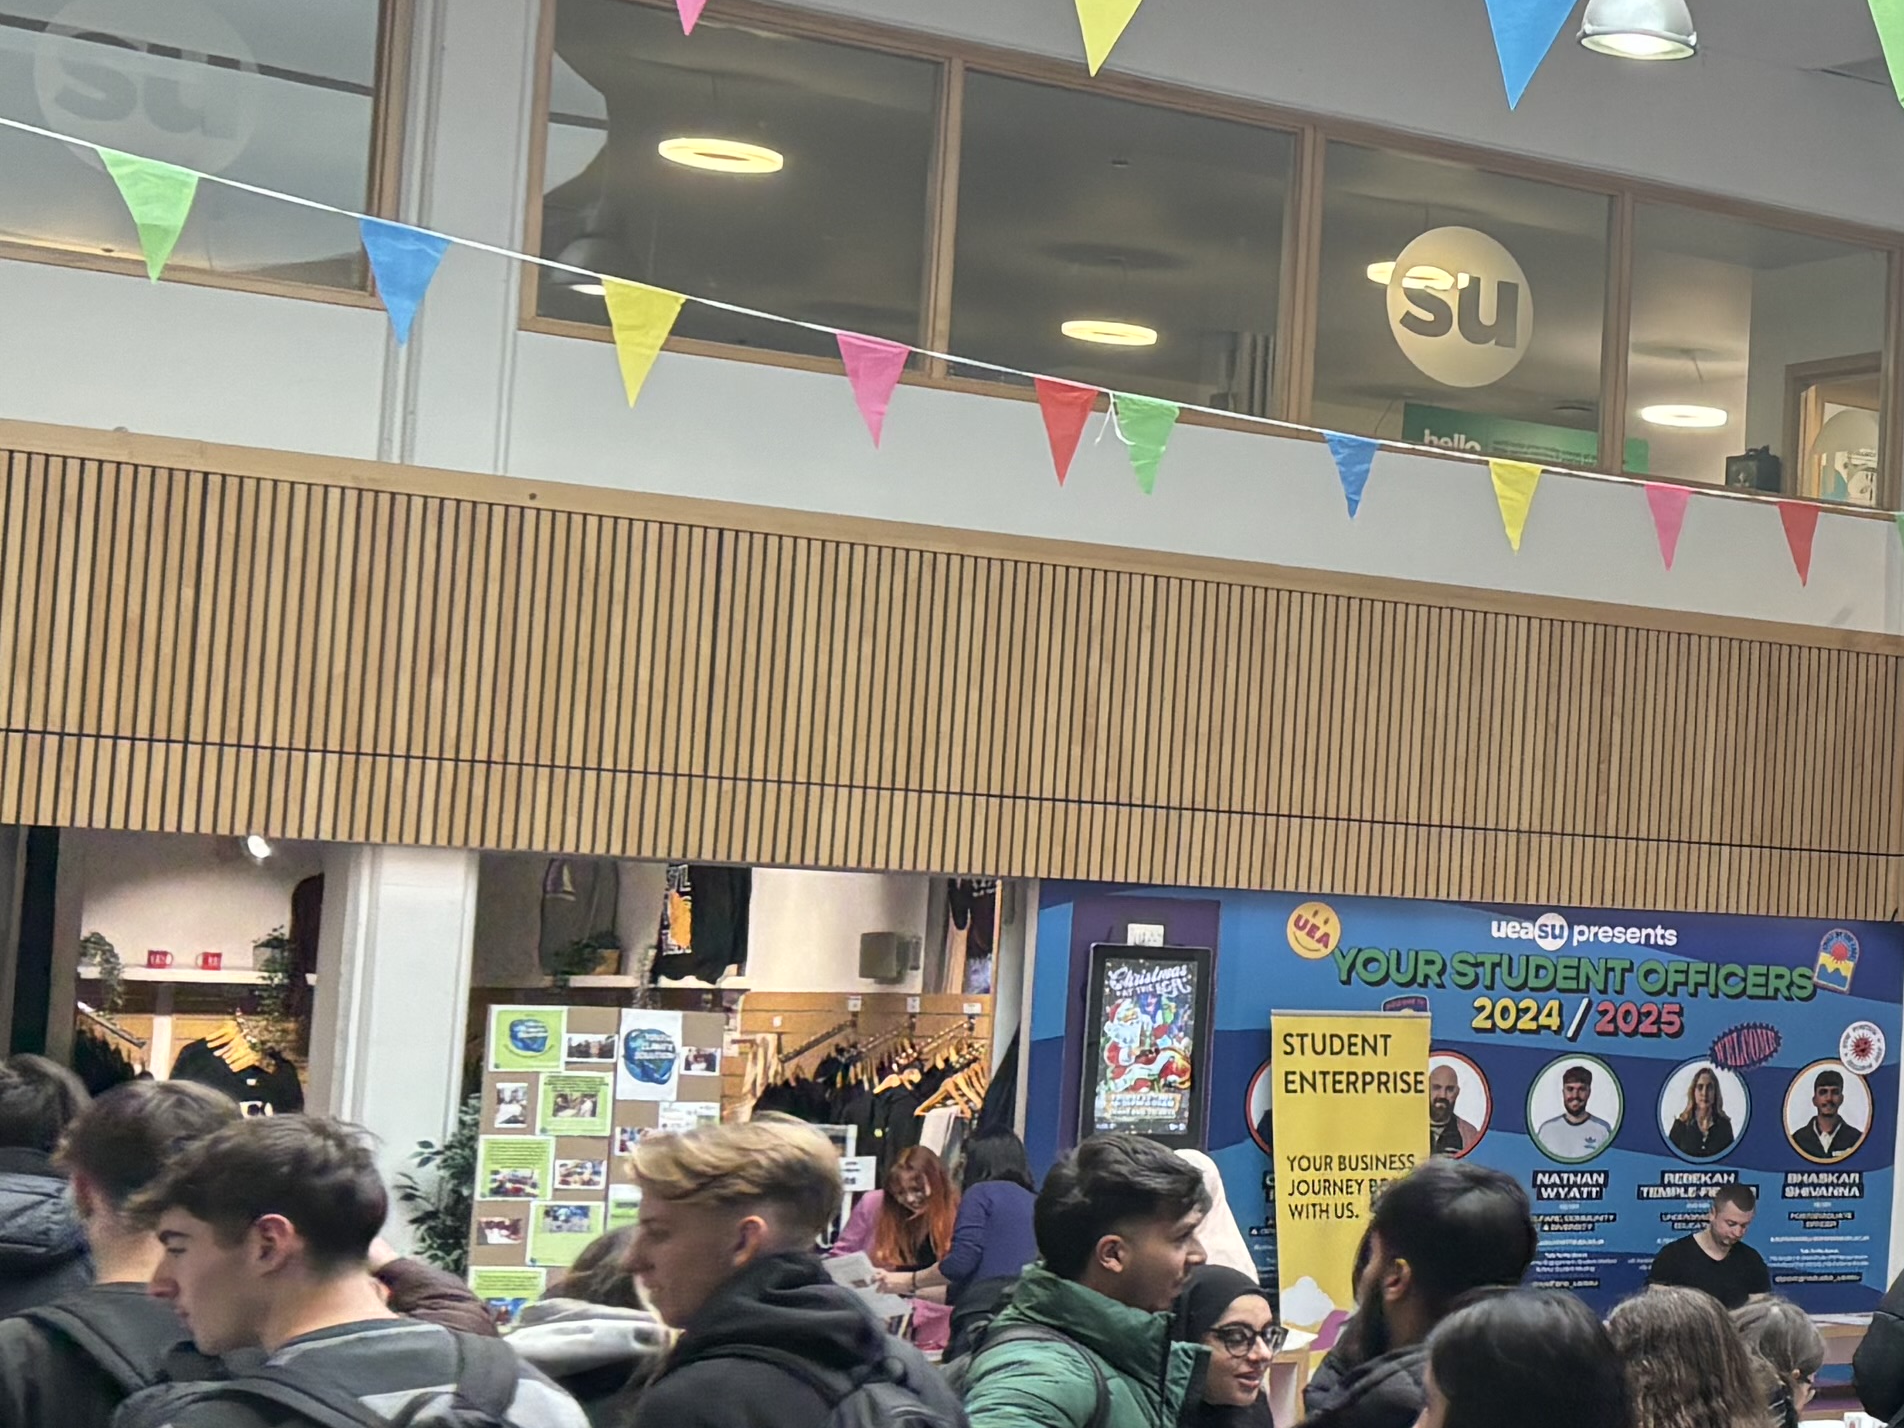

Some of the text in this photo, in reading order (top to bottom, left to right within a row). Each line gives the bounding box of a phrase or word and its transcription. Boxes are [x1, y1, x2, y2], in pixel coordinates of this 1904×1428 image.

[1398, 264, 1520, 349] su
[1293, 913, 1332, 950] UEA
[1572, 922, 1678, 947] presents
[1107, 964, 1189, 992] Christmas
[1333, 947, 1818, 1001] YOUR STUDENT OFFICERS
[1471, 995, 1562, 1033] 2024
[1594, 1000, 1683, 1036] 2025
[1282, 1032, 1392, 1057] STUDENT
[1714, 1027, 1778, 1067] WELCOME
[1283, 1070, 1426, 1094] ENTERPRISE
[1286, 1153, 1416, 1173] YOUR BUSINESS
[1287, 1178, 1365, 1197] JOURNEY
[1536, 1172, 1605, 1185] NATHAN
[1786, 1172, 1861, 1184] BHASKAR
[1540, 1186, 1601, 1199] WYATT
[1784, 1186, 1862, 1198] SHIVANNA
[1288, 1202, 1360, 1220] WITH US.
